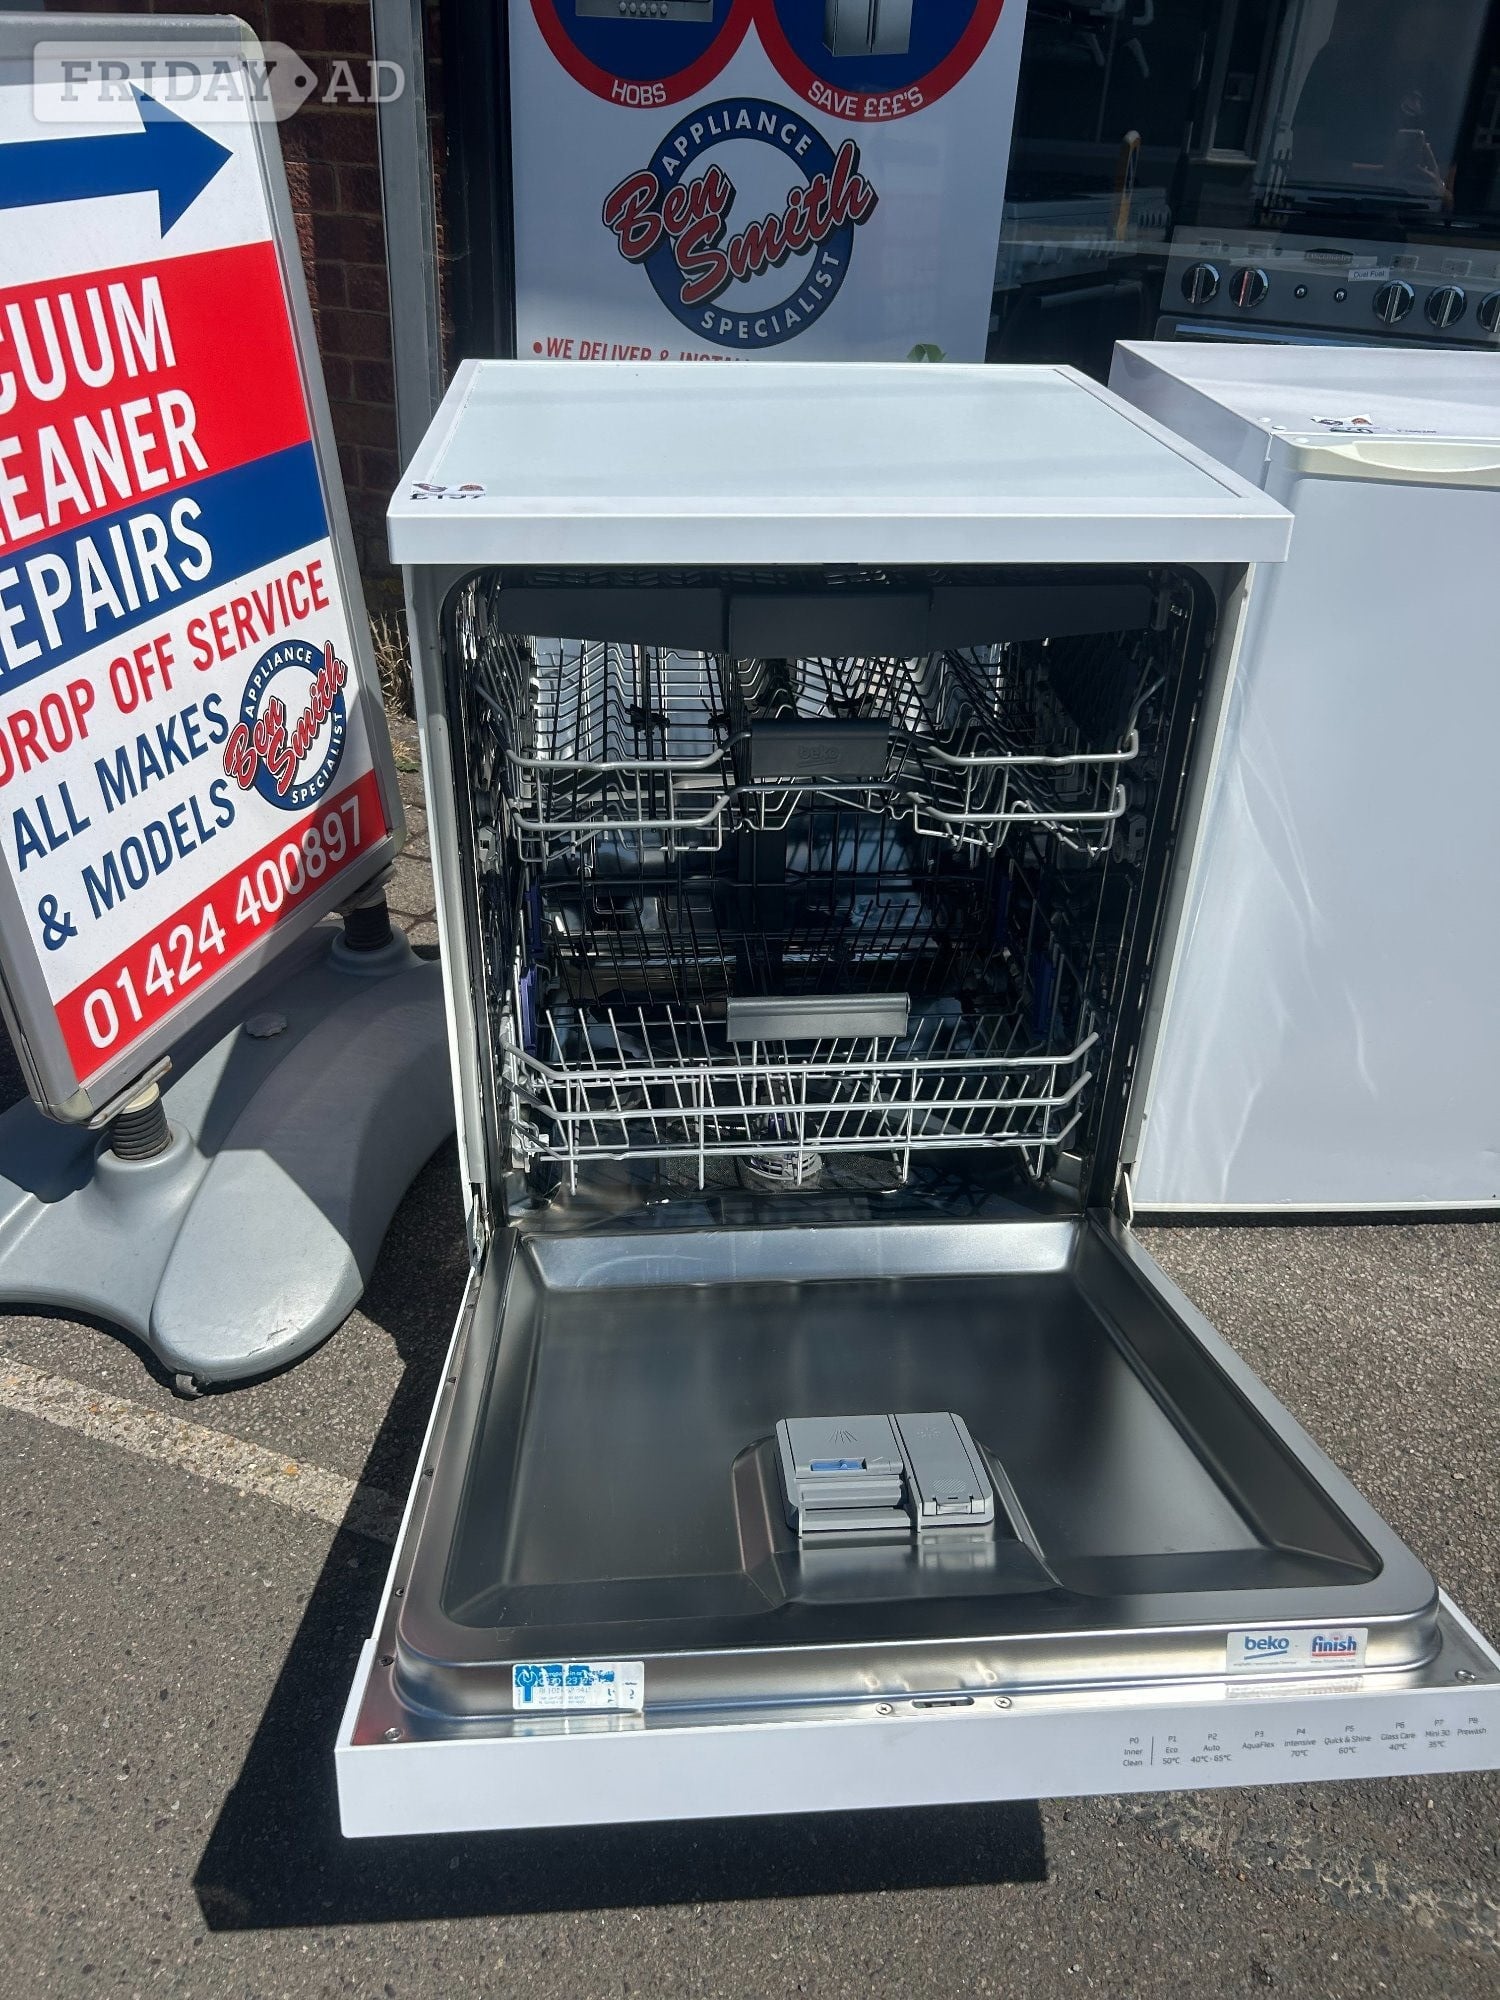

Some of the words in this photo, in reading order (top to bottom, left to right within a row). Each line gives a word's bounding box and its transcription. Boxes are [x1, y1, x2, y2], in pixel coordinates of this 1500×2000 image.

[611, 79, 667, 103] HOBS
[807, 80, 858, 116] SAVE
[661, 108, 812, 176] APPLIANCE
[602, 165, 735, 262] Ben
[675, 140, 878, 304] Smith
[701, 252, 841, 339] SPECIALIST
[547, 337, 575, 359] WE
[578, 341, 652, 361] DELIVER
[0, 389, 208, 546] EANER
[0, 497, 213, 673] EPAIRS
[109, 632, 176, 714] OFF
[186, 559, 330, 671] SERVICE
[245, 647, 313, 719] APPLIANCE
[267, 640, 347, 796] Smith
[223, 696, 285, 790] Ben
[292, 712, 343, 804] SPECIALIST
[12, 781, 92, 872] ALL
[94, 693, 229, 814] MAKES
[38, 894, 78, 951] &
[81, 779, 235, 920] MODELS
[83, 903, 227, 1048] 01424
[235, 795, 362, 926] 400897
[1244, 1636, 1290, 1650] beko
[1312, 1636, 1357, 1652] finish
[1168, 1735, 1177, 1743] P1
[1242, 1741, 1275, 1750] AquaFlex
[1254, 1730, 1264, 1738] P3
[1284, 1738, 1317, 1747] Intensive
[1324, 1737, 1344, 1745] Quick
[1351, 1735, 1372, 1743] Shine
[1380, 1733, 1399, 1741] Glass
[1400, 1732, 1416, 1740] Care
[1425, 1729, 1440, 1737] Mini
[1457, 1727, 1487, 1736] Prewash
[1122, 1759, 1143, 1767] Clean
[1162, 1757, 1180, 1765] 50°C
[1165, 1746, 1178, 1754] Eco
[1203, 1744, 1221, 1752] Auto
